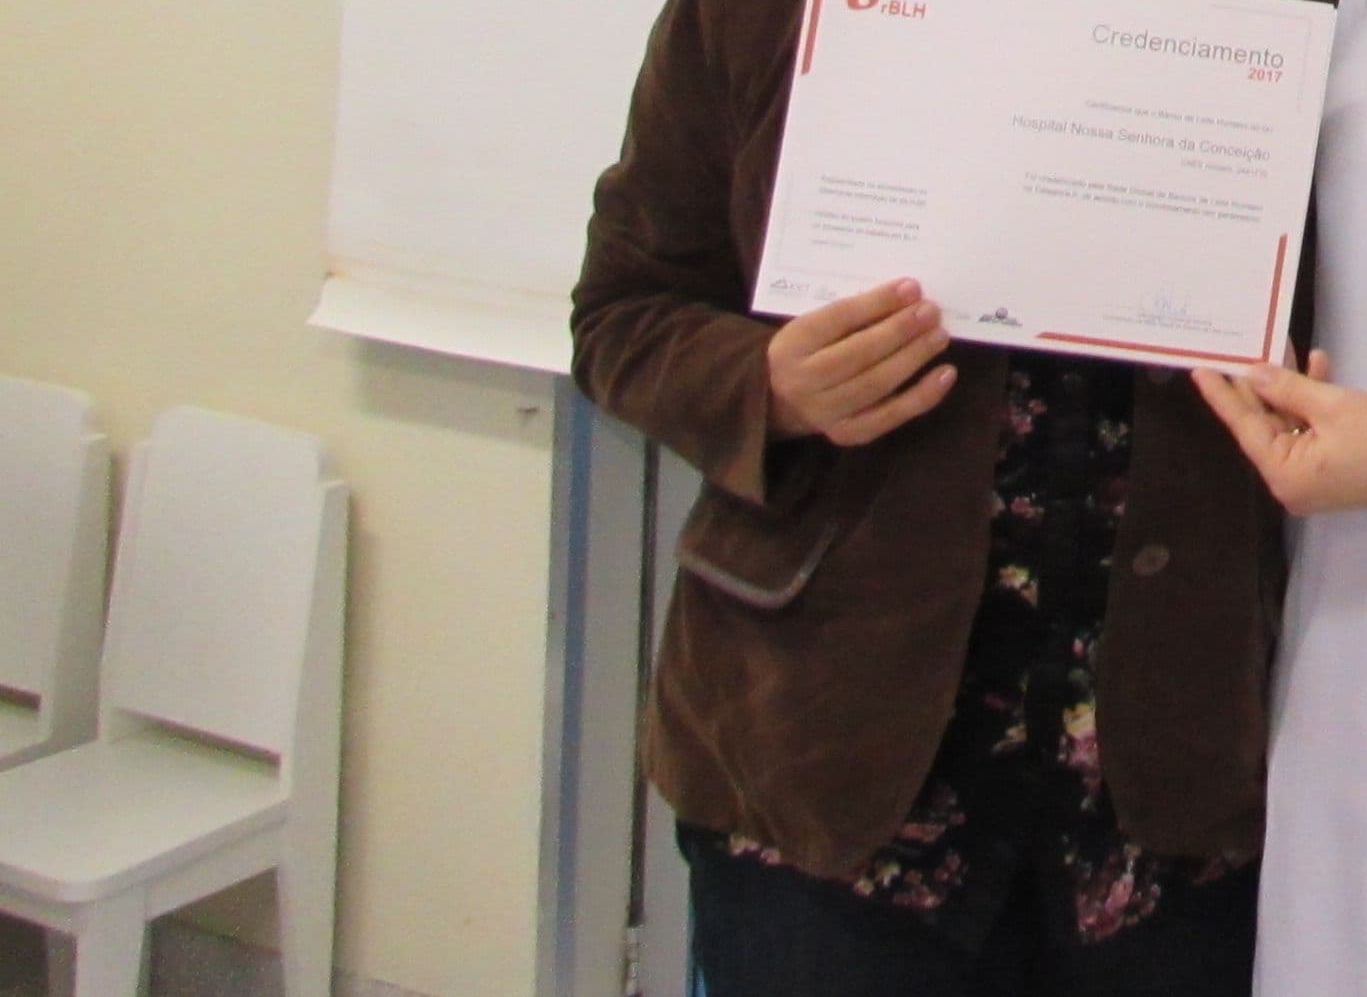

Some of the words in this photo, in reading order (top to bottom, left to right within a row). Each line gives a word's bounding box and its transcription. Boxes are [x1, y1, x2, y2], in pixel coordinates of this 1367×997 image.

[1092, 24, 1285, 70] Credenciamento
[1247, 67, 1283, 84] 2017
[1012, 115, 1067, 135] Hospital
[1071, 122, 1113, 140] Nossa
[1118, 128, 1175, 149] Senhora
[1178, 137, 1196, 152] da
[1199, 139, 1271, 162] Conceição
